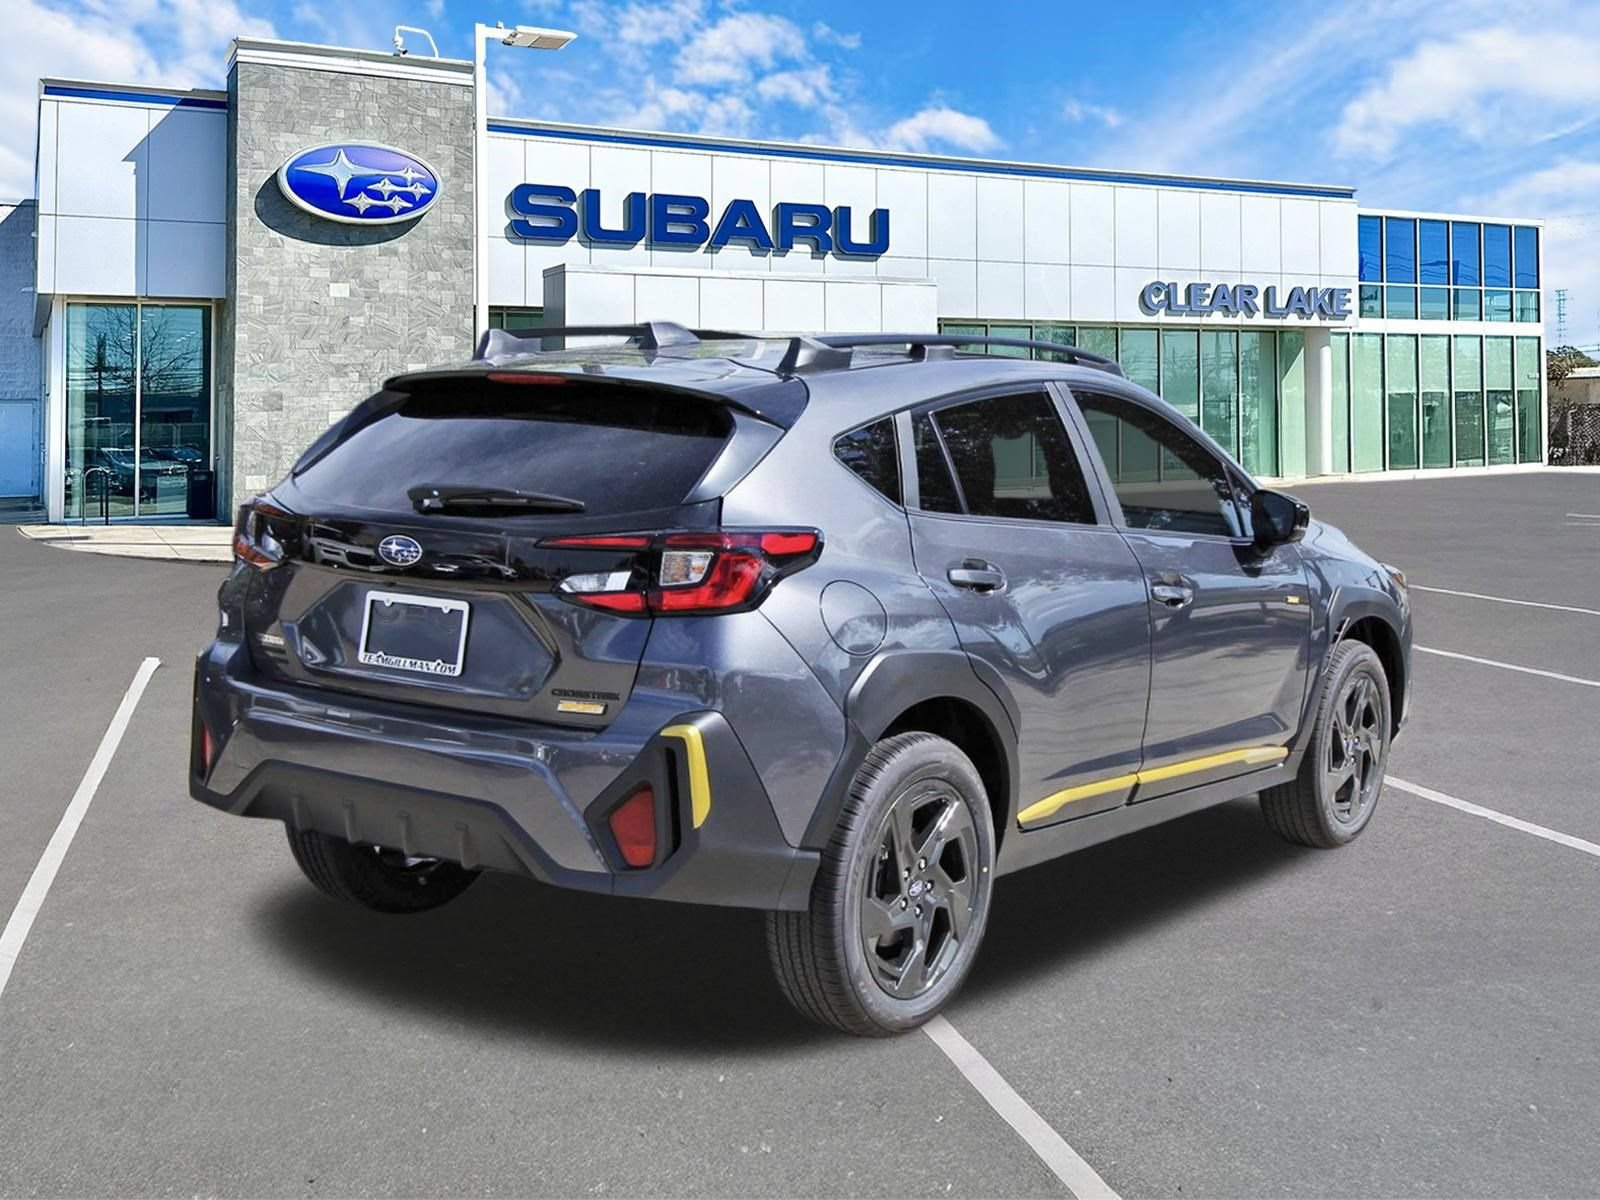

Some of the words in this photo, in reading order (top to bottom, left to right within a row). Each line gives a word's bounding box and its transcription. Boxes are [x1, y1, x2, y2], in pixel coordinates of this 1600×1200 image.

[505, 183, 890, 259] SUBARU
[1140, 281, 1260, 318] CLEAR
[1264, 286, 1352, 319] LAKE
